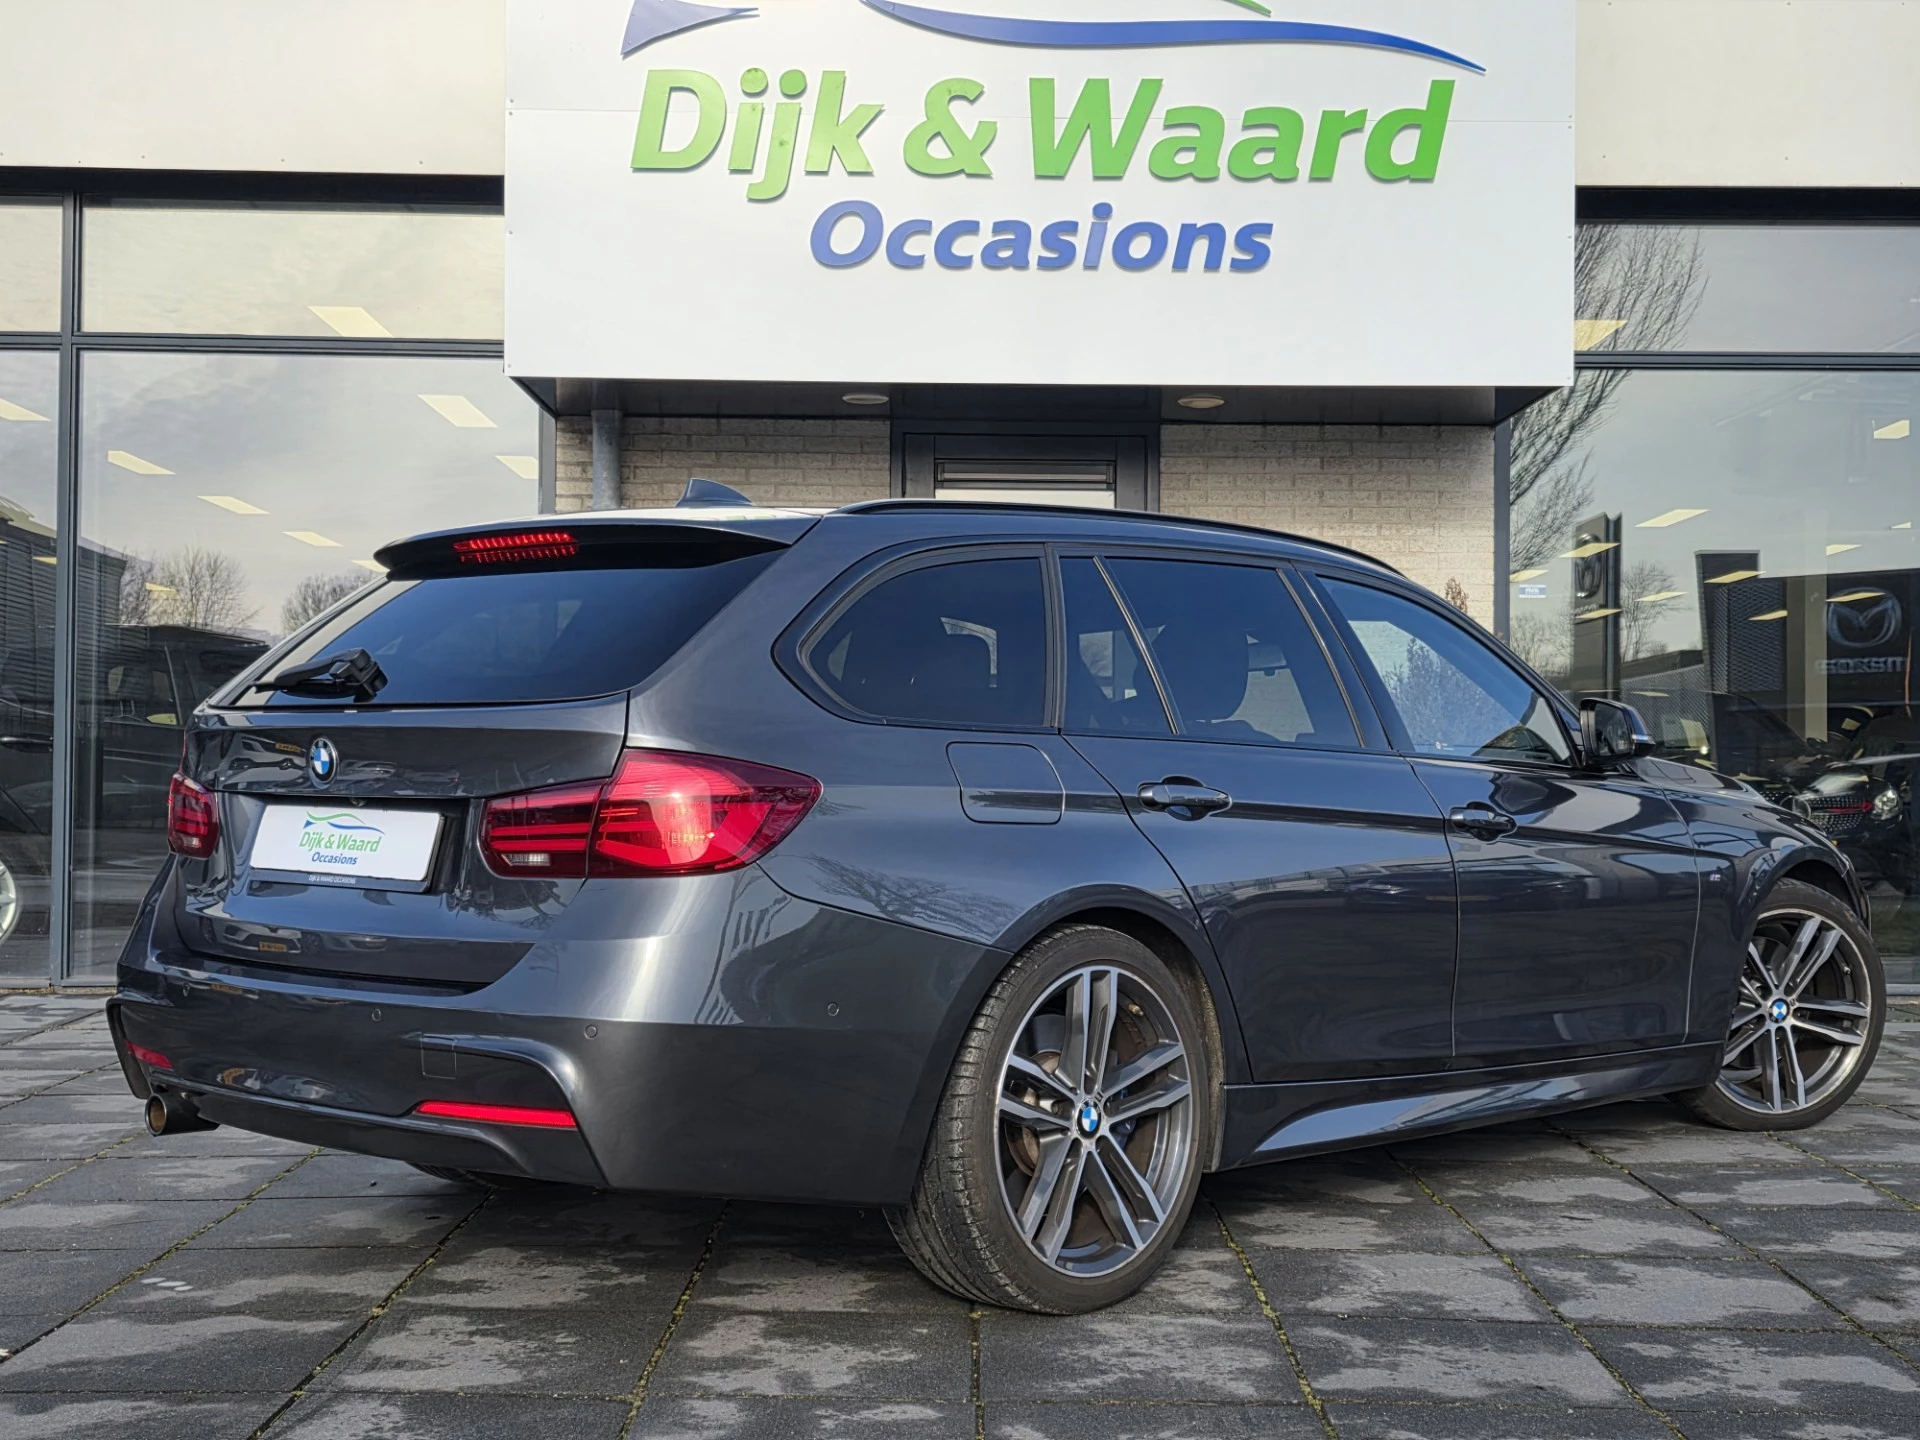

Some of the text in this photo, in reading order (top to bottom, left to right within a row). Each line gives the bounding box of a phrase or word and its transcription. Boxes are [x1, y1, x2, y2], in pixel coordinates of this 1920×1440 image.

[630, 67, 1456, 201] Dijk & Waard
[810, 200, 1274, 273] Occasions
[299, 831, 382, 852] Dijk & Waard
[311, 851, 358, 865] Occasions
